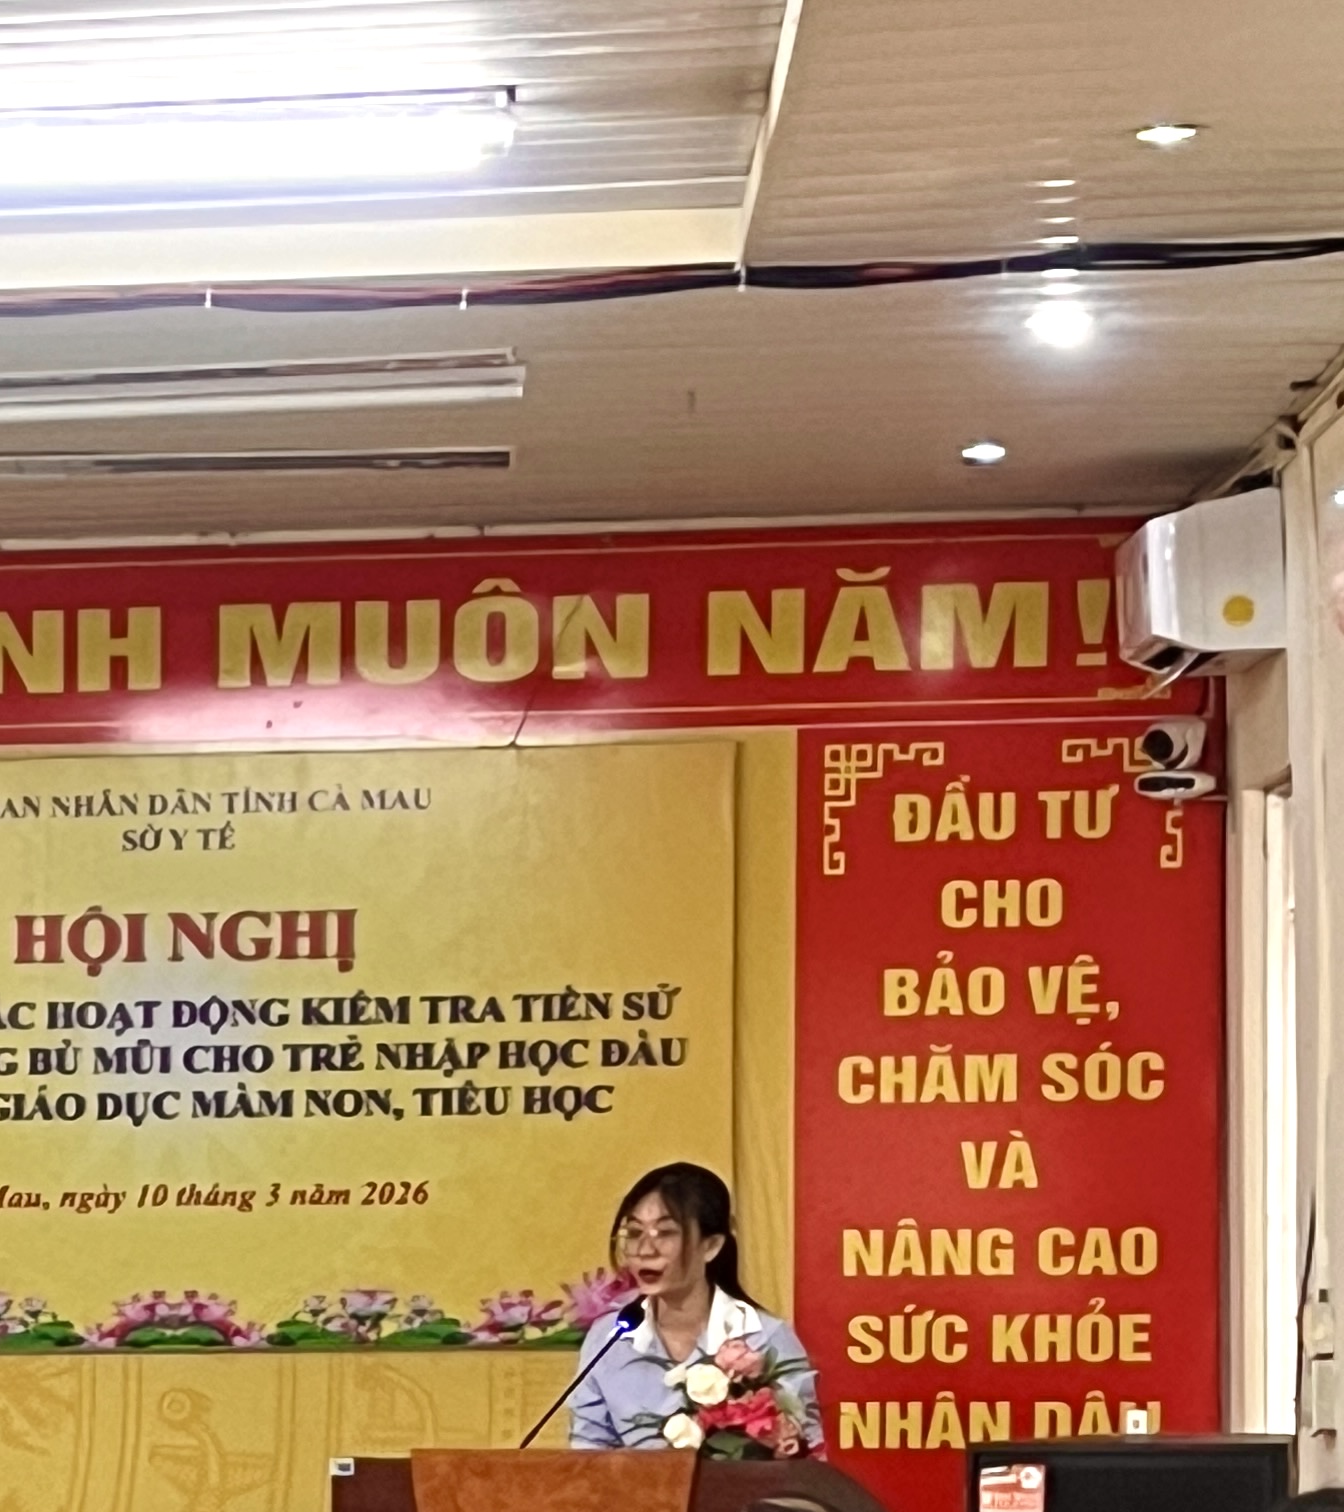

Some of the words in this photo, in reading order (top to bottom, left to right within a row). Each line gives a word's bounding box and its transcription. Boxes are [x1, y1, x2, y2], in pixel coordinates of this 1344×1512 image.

[218, 577, 649, 687] MUÔN
[707, 566, 1111, 677] NĂM!
[50, 788, 139, 818] NHÂN
[149, 787, 212, 816] DÂN
[220, 785, 298, 815] TỈNH
[308, 783, 351, 812] CÀ
[361, 787, 432, 811] MAU
[893, 775, 1016, 842] ĐẦU
[1038, 784, 1119, 839] TƯ
[169, 828, 189, 851] Y
[196, 820, 236, 851] TẾ
[941, 878, 1063, 928] CHO
[14, 904, 148, 977] HỘI
[168, 908, 358, 973] NGHỊ
[46, 999, 162, 1036] HOẠT
[171, 994, 290, 1035] ĐỘNG
[301, 989, 411, 1026] KIỂM
[419, 994, 506, 1024] TRA
[512, 984, 614, 1023] TIỀN
[883, 950, 1005, 1016] BẢO
[1028, 954, 1119, 1025] VỆ,
[92, 1038, 172, 1075] MŨI
[182, 1043, 275, 1074] CHO
[282, 1034, 365, 1072] TRẺ
[374, 1037, 491, 1078] NHẬP
[498, 1038, 590, 1077] HỌC
[600, 1028, 690, 1068] ĐẦU
[837, 1043, 1018, 1104] CHĂM
[1041, 1041, 1165, 1101] SÓC
[96, 1090, 181, 1127] DỤC
[191, 1081, 294, 1119] MẦM
[303, 1088, 405, 1121] NON,
[412, 1079, 512, 1117] TIỂU
[523, 1084, 616, 1121] HỌC
[961, 1130, 1039, 1189] VÀ
[58, 1183, 126, 1214] ngày
[136, 1184, 169, 1209] 10
[176, 1184, 257, 1213] tháng
[265, 1183, 280, 1208] 3
[289, 1183, 351, 1206] năm
[360, 1180, 431, 1206] 2026
[842, 1218, 1014, 1276] NÂNG
[1038, 1226, 1158, 1276] CAO
[846, 1303, 968, 1364] SỨC
[991, 1297, 1152, 1363] KHỎE
[839, 1390, 1011, 1449] NHÂN
